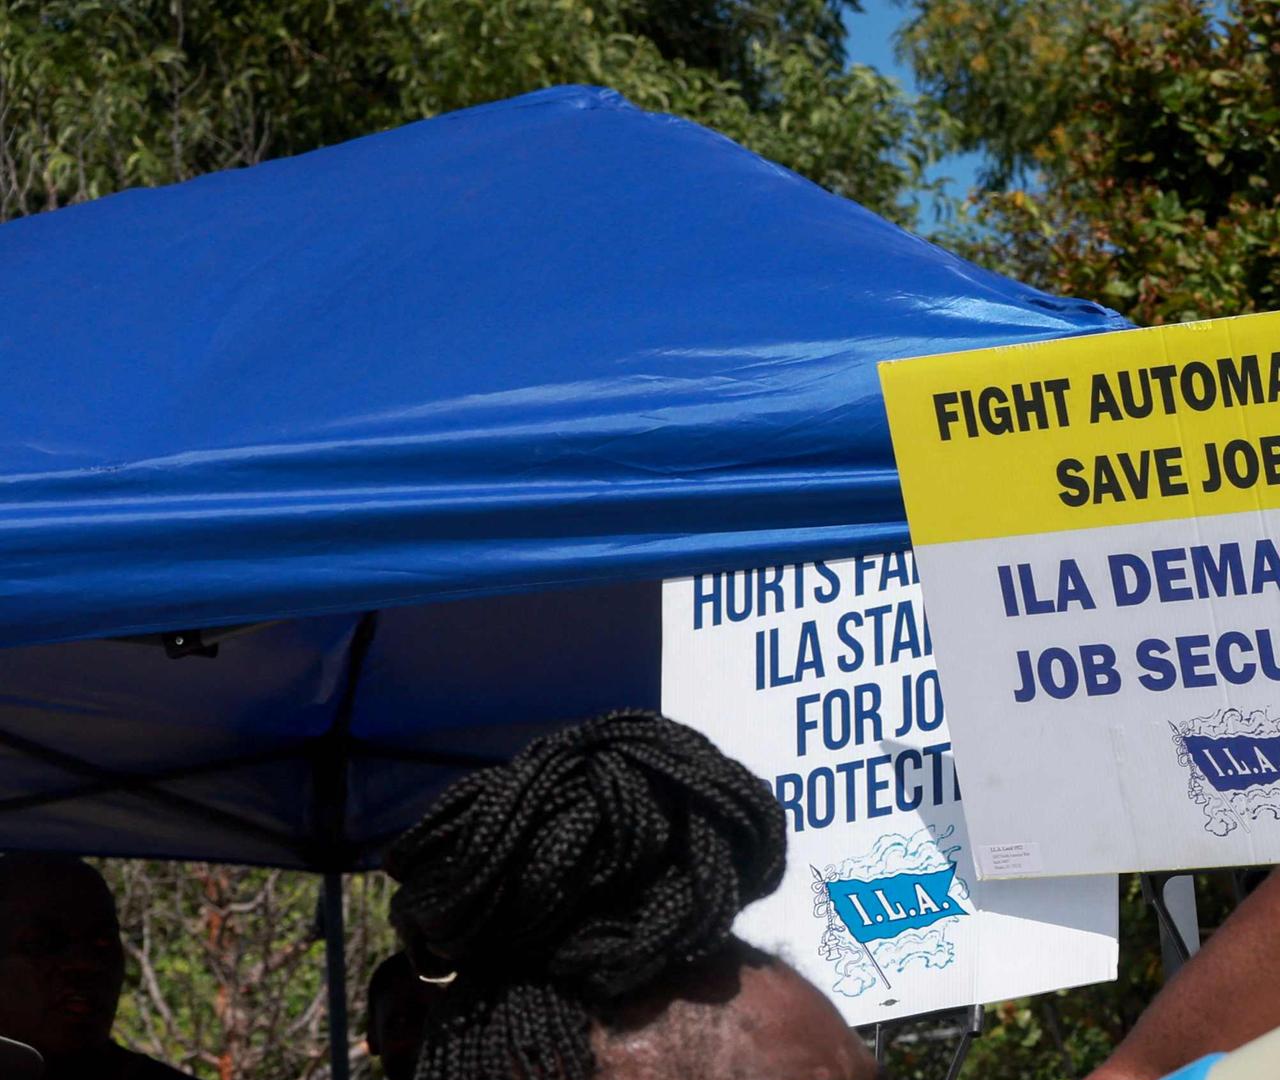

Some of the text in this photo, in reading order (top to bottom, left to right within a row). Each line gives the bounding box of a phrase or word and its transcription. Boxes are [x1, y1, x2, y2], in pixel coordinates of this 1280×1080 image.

[932, 377, 1071, 441] FIGHT
[1056, 446, 1189, 508] SAVE
[999, 559, 1095, 617] ILA
[755, 600, 934, 691] ILA STA
[1014, 643, 1122, 702] JOB
[796, 682, 884, 758] FOR
[848, 883, 950, 926] I.L.A.
